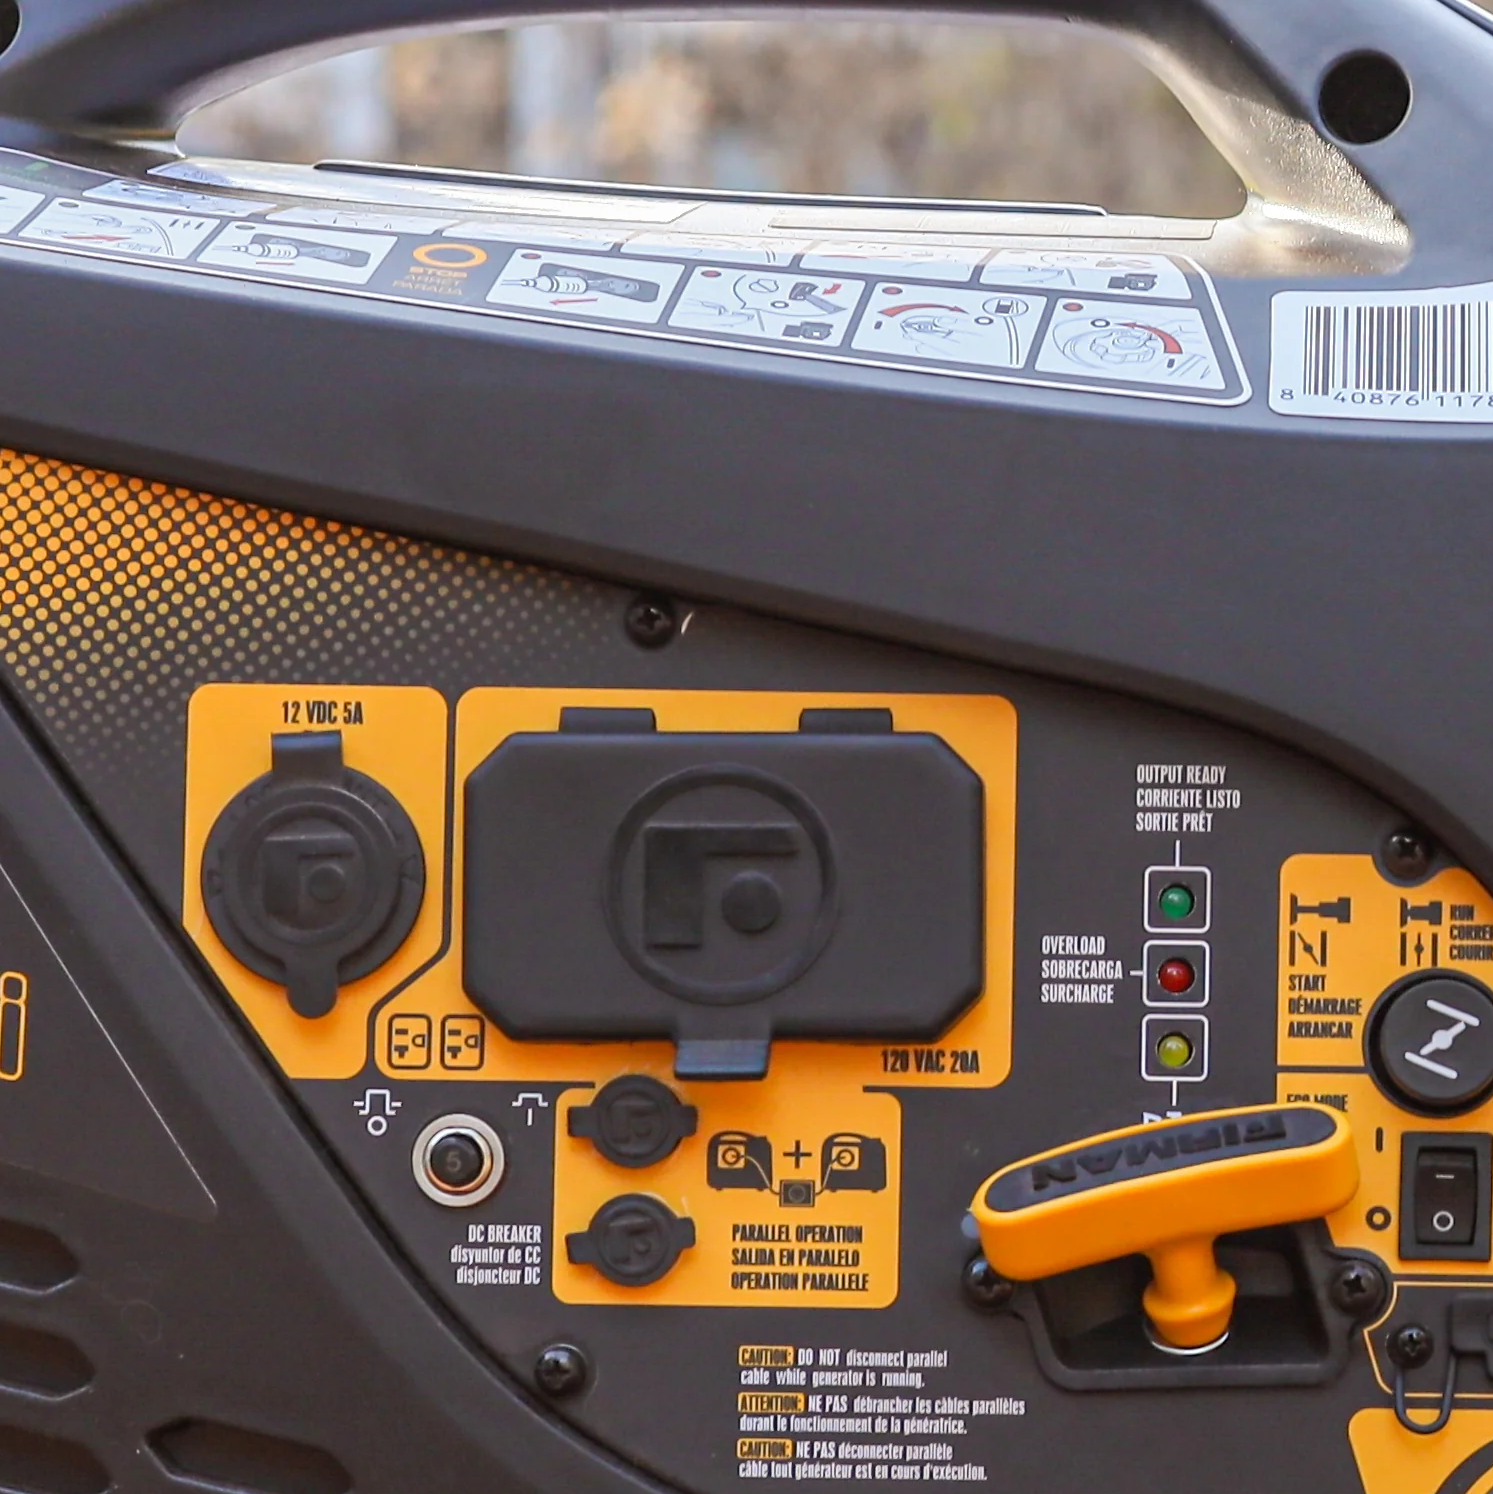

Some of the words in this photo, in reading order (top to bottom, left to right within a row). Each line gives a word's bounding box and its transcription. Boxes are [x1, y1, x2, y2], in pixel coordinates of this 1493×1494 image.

[1280, 388, 1295, 400] 8
[1332, 391, 1420, 406] 40876
[281, 700, 301, 724] 12
[305, 700, 339, 725] VDC
[342, 701, 364, 725] 5A
[1136, 764, 1183, 784] OUTPUT
[1186, 765, 1227, 785] READY
[1136, 788, 1203, 808] CORRIENTE
[1206, 789, 1241, 809] LISTO
[1136, 811, 1179, 832] SORTIE
[1182, 809, 1214, 833] PRÊT
[1450, 904, 1475, 921] RUN
[1041, 936, 1106, 955] OVERLOAD
[1041, 960, 1124, 980] SOBRECARGA
[1288, 974, 1327, 992] START
[1041, 984, 1114, 1004] SURCHARGE
[1288, 995, 1363, 1015] DÉMARRAGE
[1288, 1021, 1353, 1038] ARRANCAR
[881, 1049, 910, 1072] 120
[914, 1050, 945, 1073] VAC
[950, 1050, 980, 1074] 20A
[1031, 1113, 1287, 1192] FIRMAN
[468, 1224, 485, 1243] DC
[487, 1225, 542, 1243] BREAKER
[732, 1224, 792, 1242] PARALLEL
[796, 1225, 863, 1243] OPERATION
[450, 1245, 505, 1265] disyuntor
[507, 1246, 522, 1264] de
[525, 1246, 541, 1264] CC
[731, 1248, 775, 1266] SALIDA
[780, 1249, 794, 1266] EN
[798, 1249, 860, 1267] PARALELO
[456, 1266, 522, 1286] disjoncteur
[524, 1266, 541, 1285] DC
[731, 1272, 798, 1290] OPERATION
[802, 1273, 869, 1291] PARALLELE
[741, 1347, 792, 1365] CAUTION:
[798, 1348, 814, 1366] DO
[818, 1348, 841, 1366] NOT
[846, 1349, 904, 1367] disconnect
[907, 1350, 948, 1369] parallel
[740, 1368, 770, 1385] cable
[776, 1368, 807, 1385] while
[812, 1369, 863, 1388] generator
[865, 1369, 876, 1386] is
[881, 1369, 926, 1389] running.
[740, 1394, 803, 1412] ATTENTION:
[808, 1395, 823, 1412] NE
[825, 1395, 848, 1412] PAS
[853, 1396, 913, 1414] débrancher
[915, 1397, 932, 1414] les
[739, 1414, 775, 1432] durant
[776, 1415, 788, 1432] le
[789, 1415, 873, 1433] fonctionnement
[874, 1416, 889, 1433] de
[890, 1416, 901, 1433] la
[739, 1440, 791, 1458] CAUTION:
[795, 1441, 811, 1458] NE
[813, 1441, 836, 1458] PAS
[838, 1442, 904, 1460] déconnecter
[770, 1461, 793, 1478] tout
[855, 1463, 873, 1479] est
[874, 1464, 889, 1479] en
[891, 1464, 921, 1480] cours
